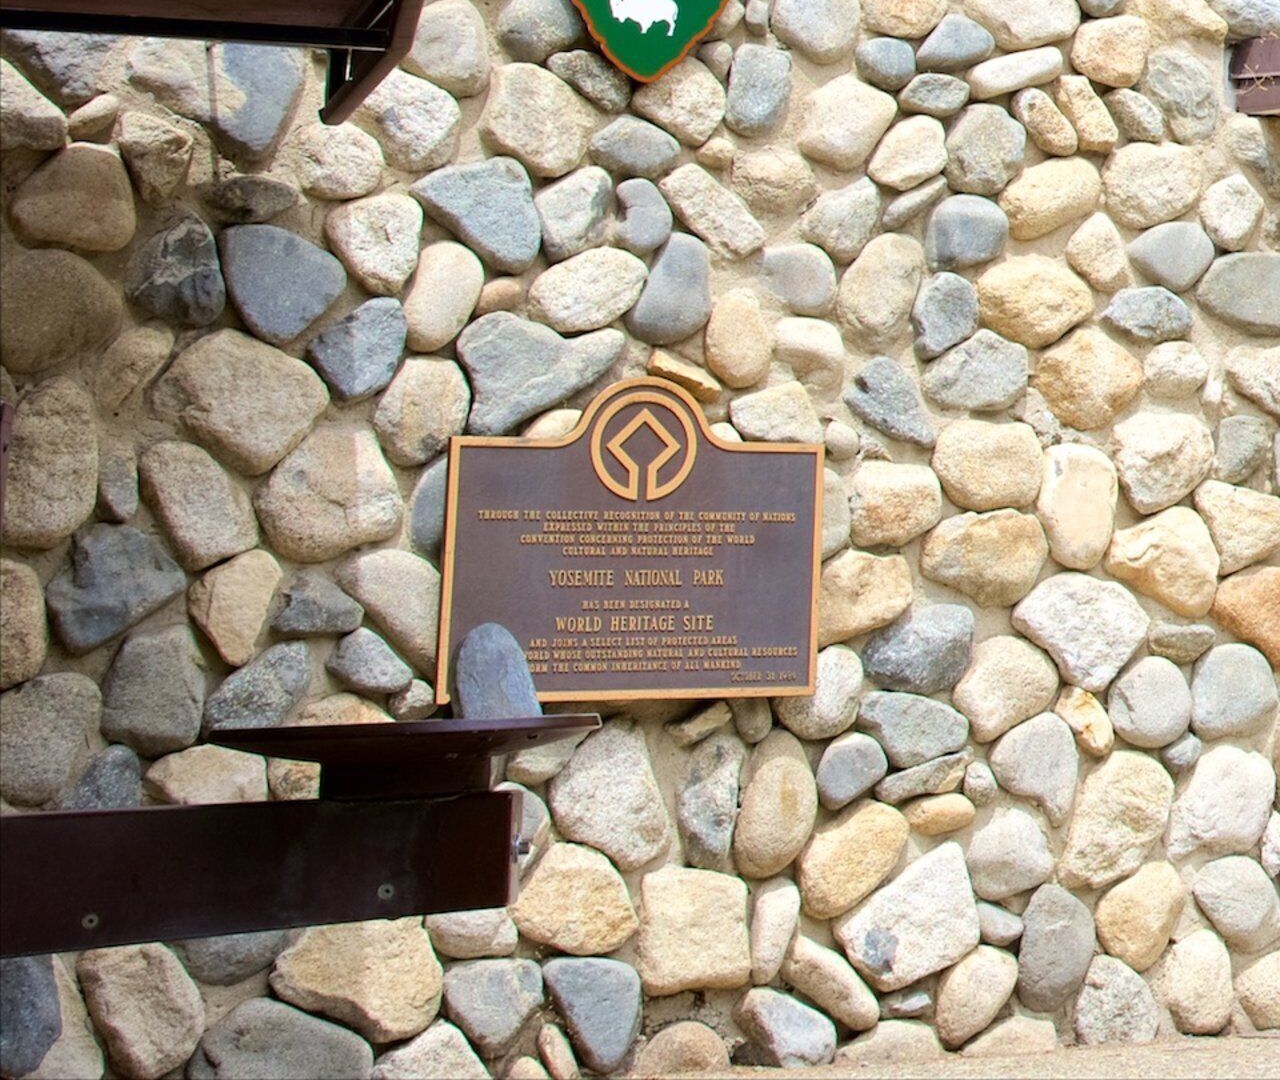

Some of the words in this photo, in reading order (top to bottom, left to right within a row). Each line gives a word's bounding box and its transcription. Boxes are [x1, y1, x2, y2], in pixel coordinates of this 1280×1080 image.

[549, 569, 614, 587] YOSEMITE
[624, 569, 682, 587] NATIONAL
[693, 569, 724, 587] PARK
[555, 617, 602, 632] WORLD
[610, 616, 675, 631] HERITAGE
[683, 615, 714, 630] SITE
